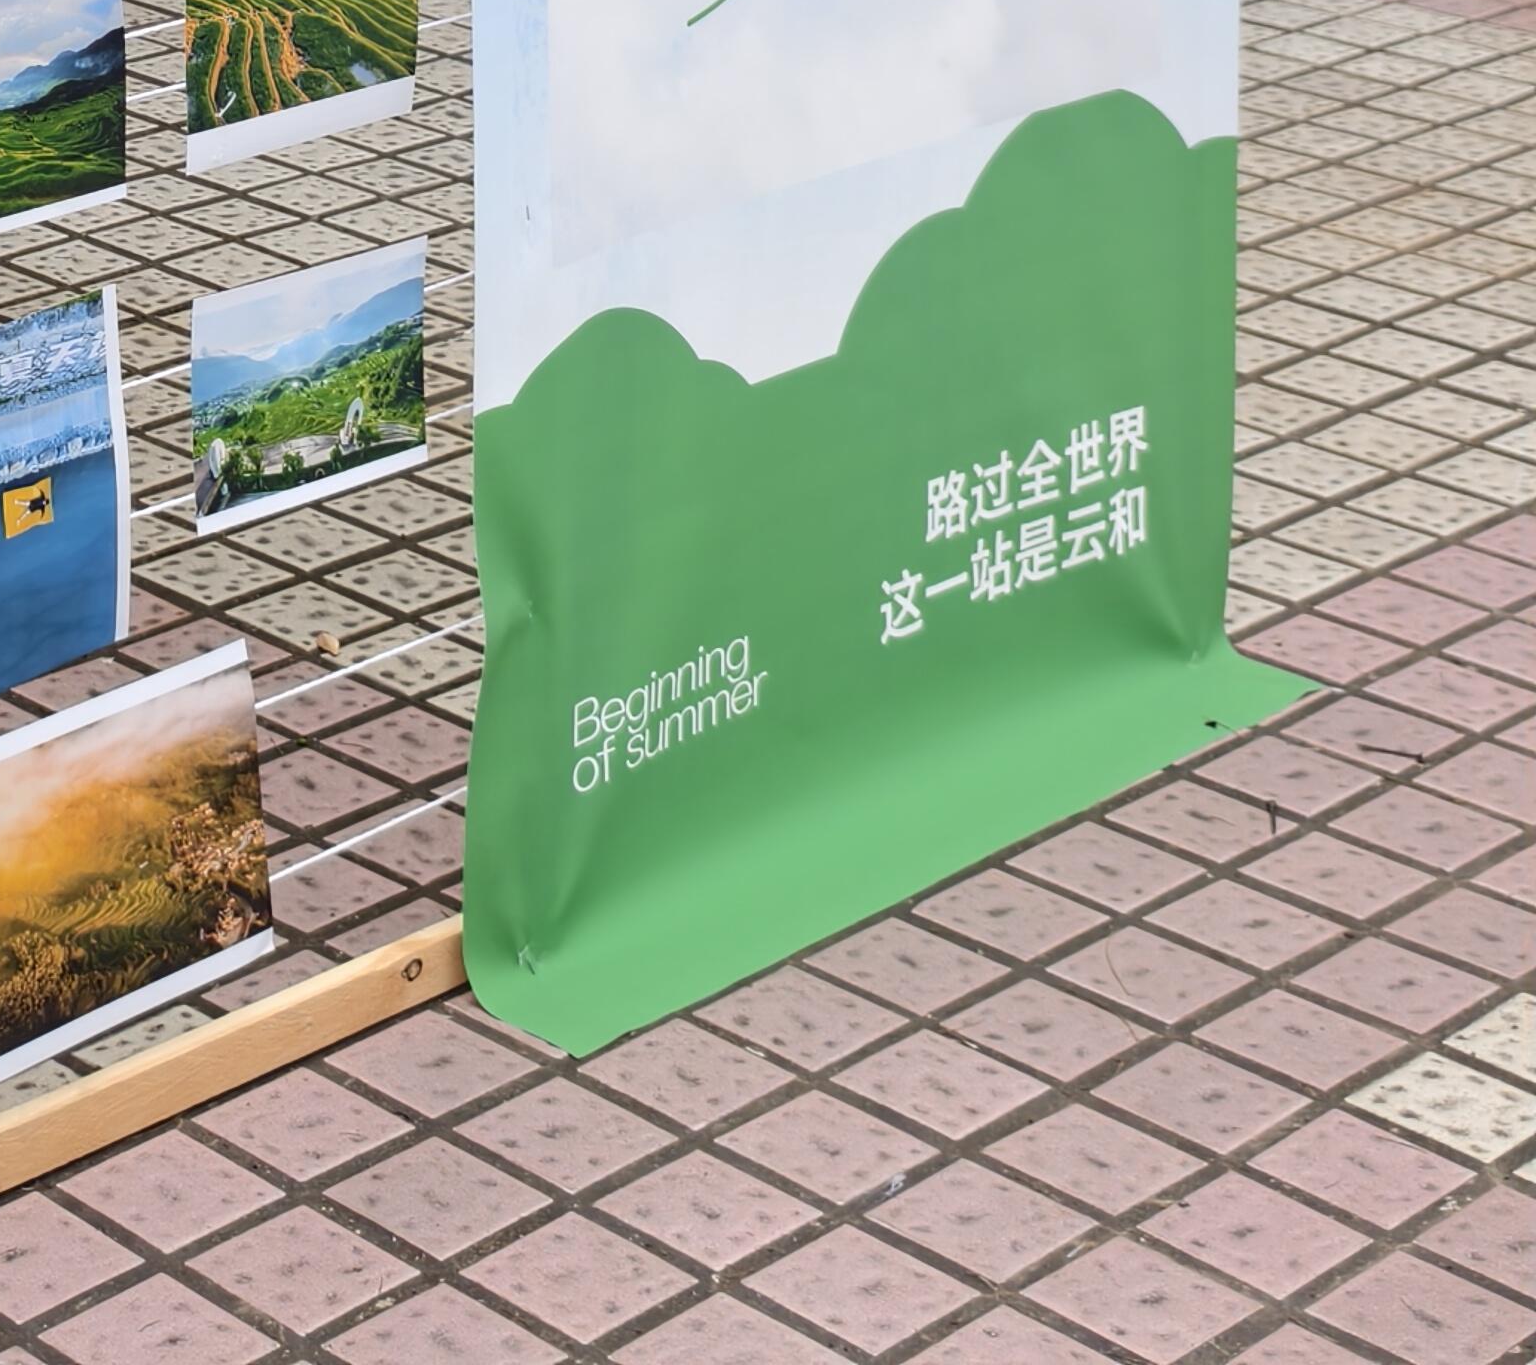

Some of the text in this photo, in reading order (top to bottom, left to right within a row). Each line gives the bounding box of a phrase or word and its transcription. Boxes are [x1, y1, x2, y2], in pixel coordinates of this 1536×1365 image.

[925, 405, 1149, 543] 路过全世界
[879, 485, 1148, 645] 这一站是云和
[572, 670, 769, 793] of summer
[573, 635, 750, 749] Beginning
